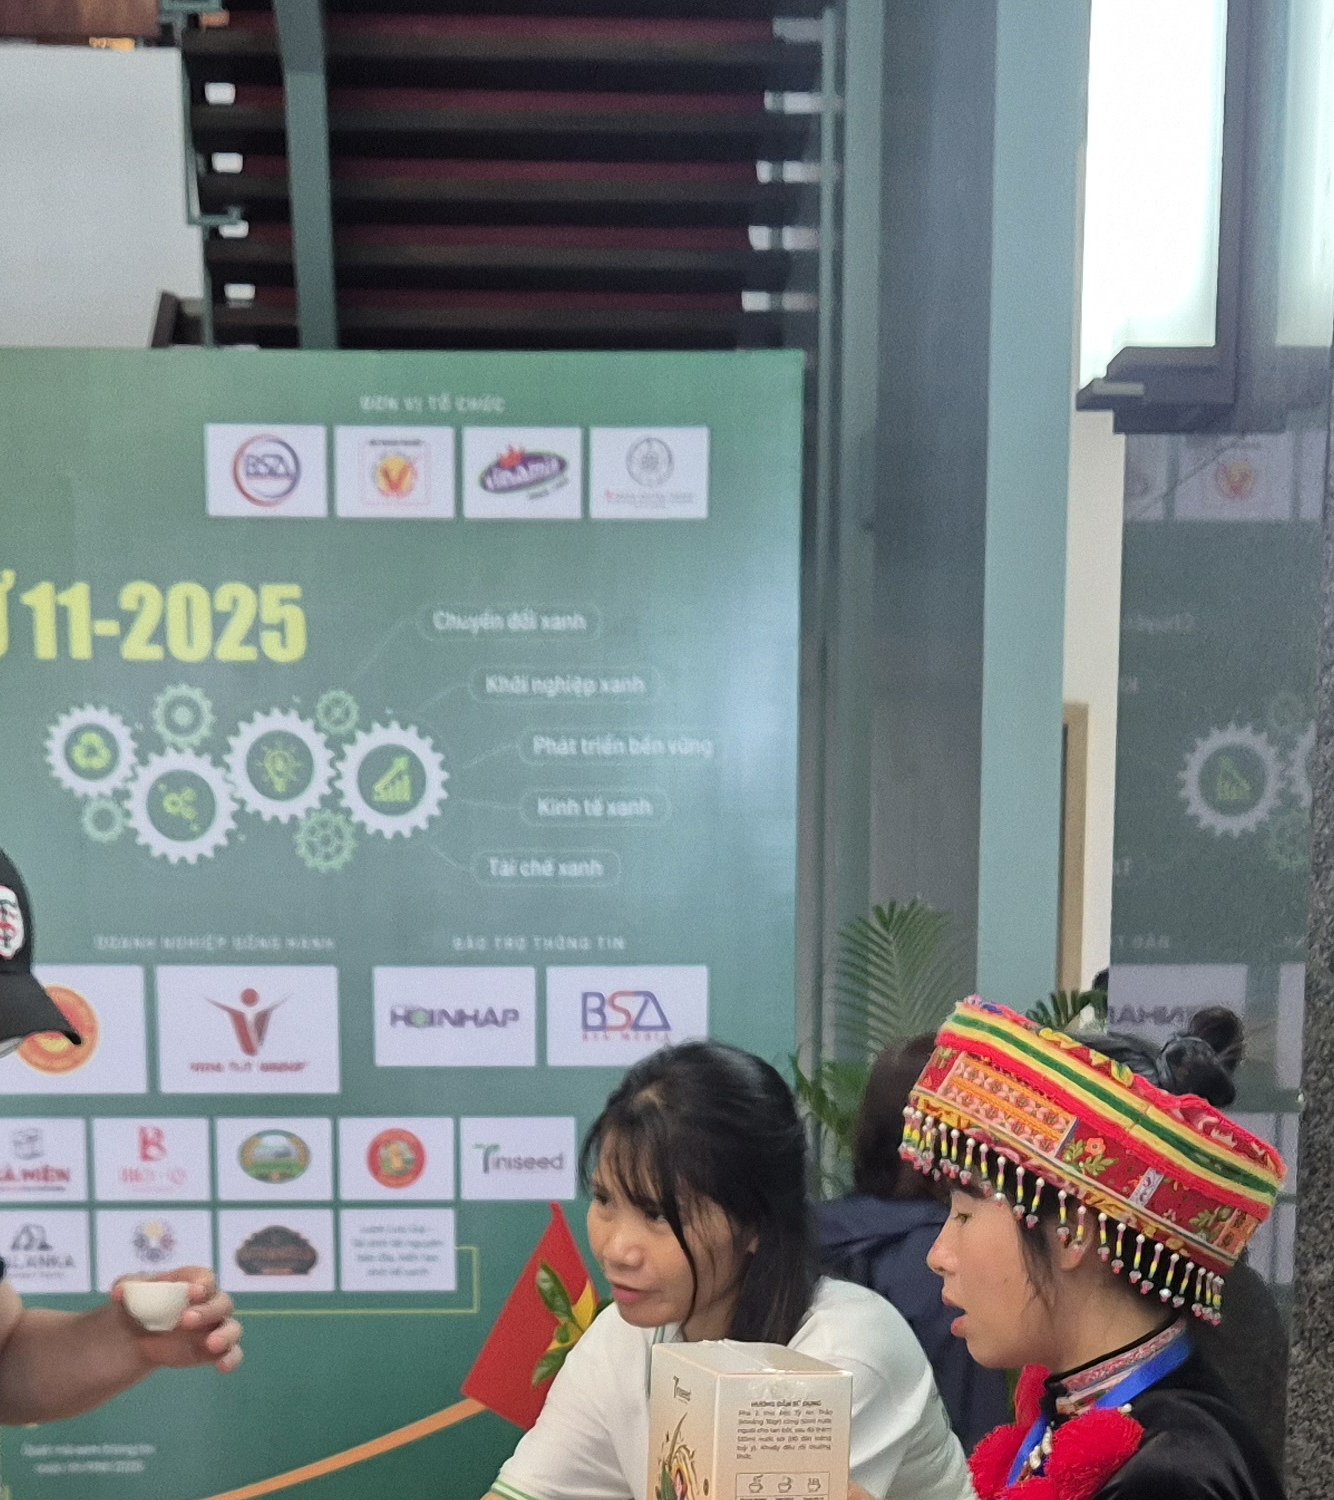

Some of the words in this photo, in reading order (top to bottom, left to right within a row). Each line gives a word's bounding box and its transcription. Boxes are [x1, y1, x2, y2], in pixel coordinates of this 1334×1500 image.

[21, 580, 308, 663] 11-2025
[541, 611, 587, 630] xanh
[606, 798, 654, 816] xanh
[558, 859, 604, 876] xanh
[581, 990, 671, 1031] BSA
[473, 1143, 564, 1174] Tiniseed
